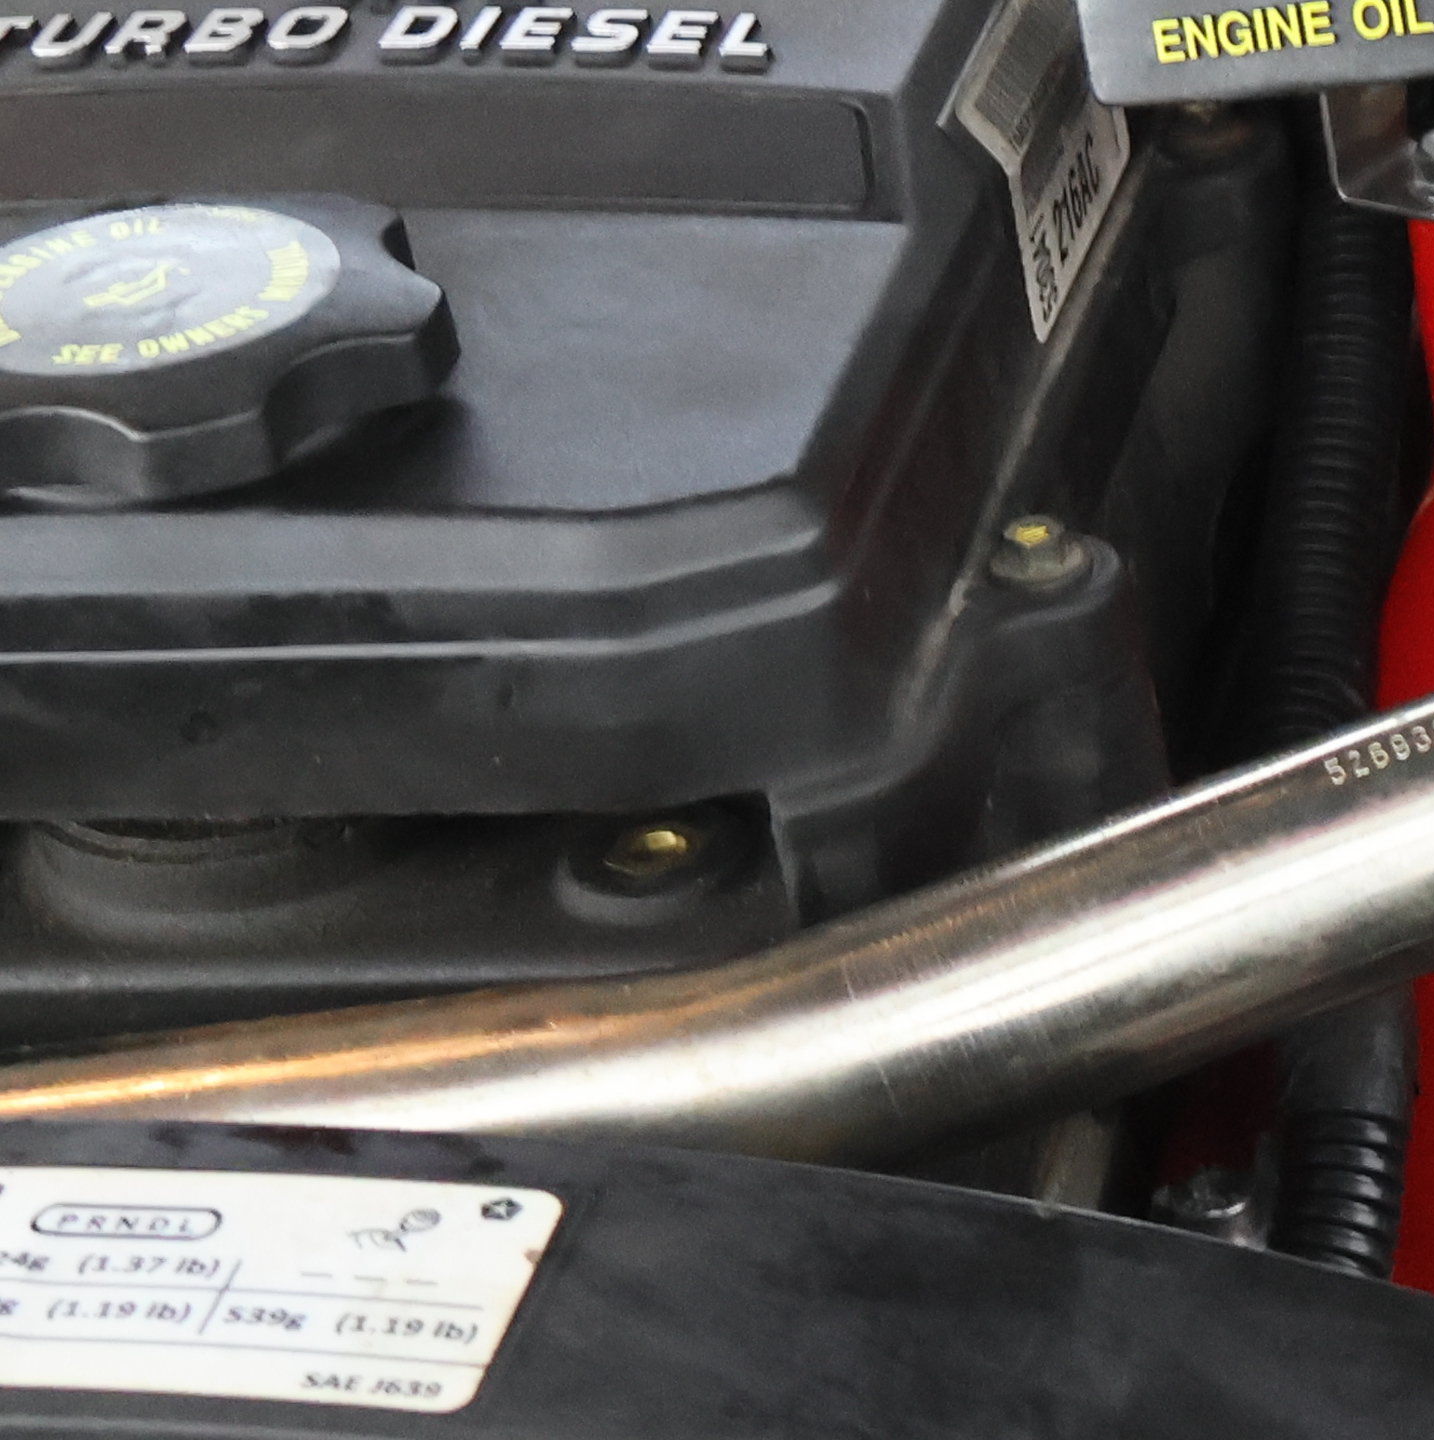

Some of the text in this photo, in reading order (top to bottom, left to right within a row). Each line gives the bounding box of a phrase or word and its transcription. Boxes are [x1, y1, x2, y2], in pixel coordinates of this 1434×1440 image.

[378, 5, 774, 59] DIESEL
[51, 342, 124, 366] SEE
[301, 1372, 361, 1392] SAE
